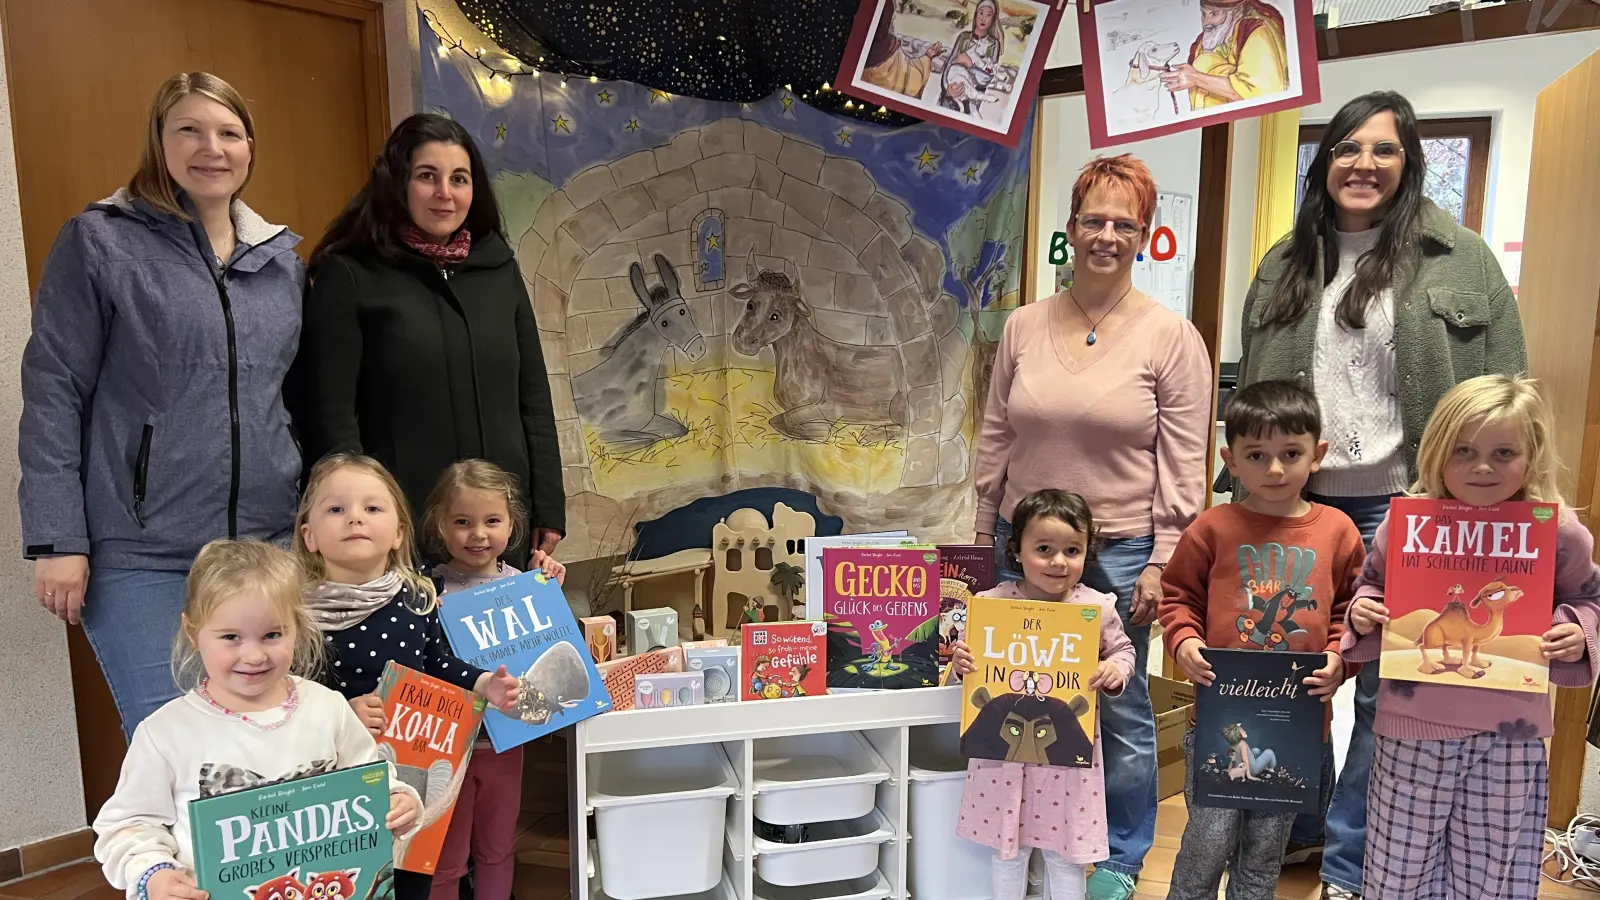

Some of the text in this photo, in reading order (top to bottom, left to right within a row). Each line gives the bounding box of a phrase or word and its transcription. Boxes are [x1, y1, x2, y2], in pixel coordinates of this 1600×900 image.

[1435, 514, 1452, 524] DAS
[1402, 514, 1539, 559] KAMEL
[1401, 555, 1537, 575] HAT SCHLECHTE LAUNE
[834, 561, 927, 598] GECKO
[1247, 579, 1281, 594] BEAR
[494, 594, 513, 608] DER
[834, 597, 928, 617] GLÜCK DES GEBENS
[460, 595, 553, 650] WAL
[1023, 618, 1042, 631] DER
[488, 645, 518, 662] IMMER
[520, 635, 541, 652] MEHR
[543, 624, 574, 642] WOLLTE
[771, 634, 782, 644] So
[983, 626, 1082, 668] LÖWE
[771, 650, 817, 668] Gefühle
[985, 665, 1081, 690] IN DIR
[1219, 678, 1298, 699] vielleicht
[400, 683, 432, 708] TRAU
[437, 695, 464, 720] DICH
[385, 703, 458, 755] KOALA
[250, 801, 293, 820] KLEINE
[215, 795, 379, 864] PANDAS,
[285, 831, 379, 867] VERSPRECHEN
